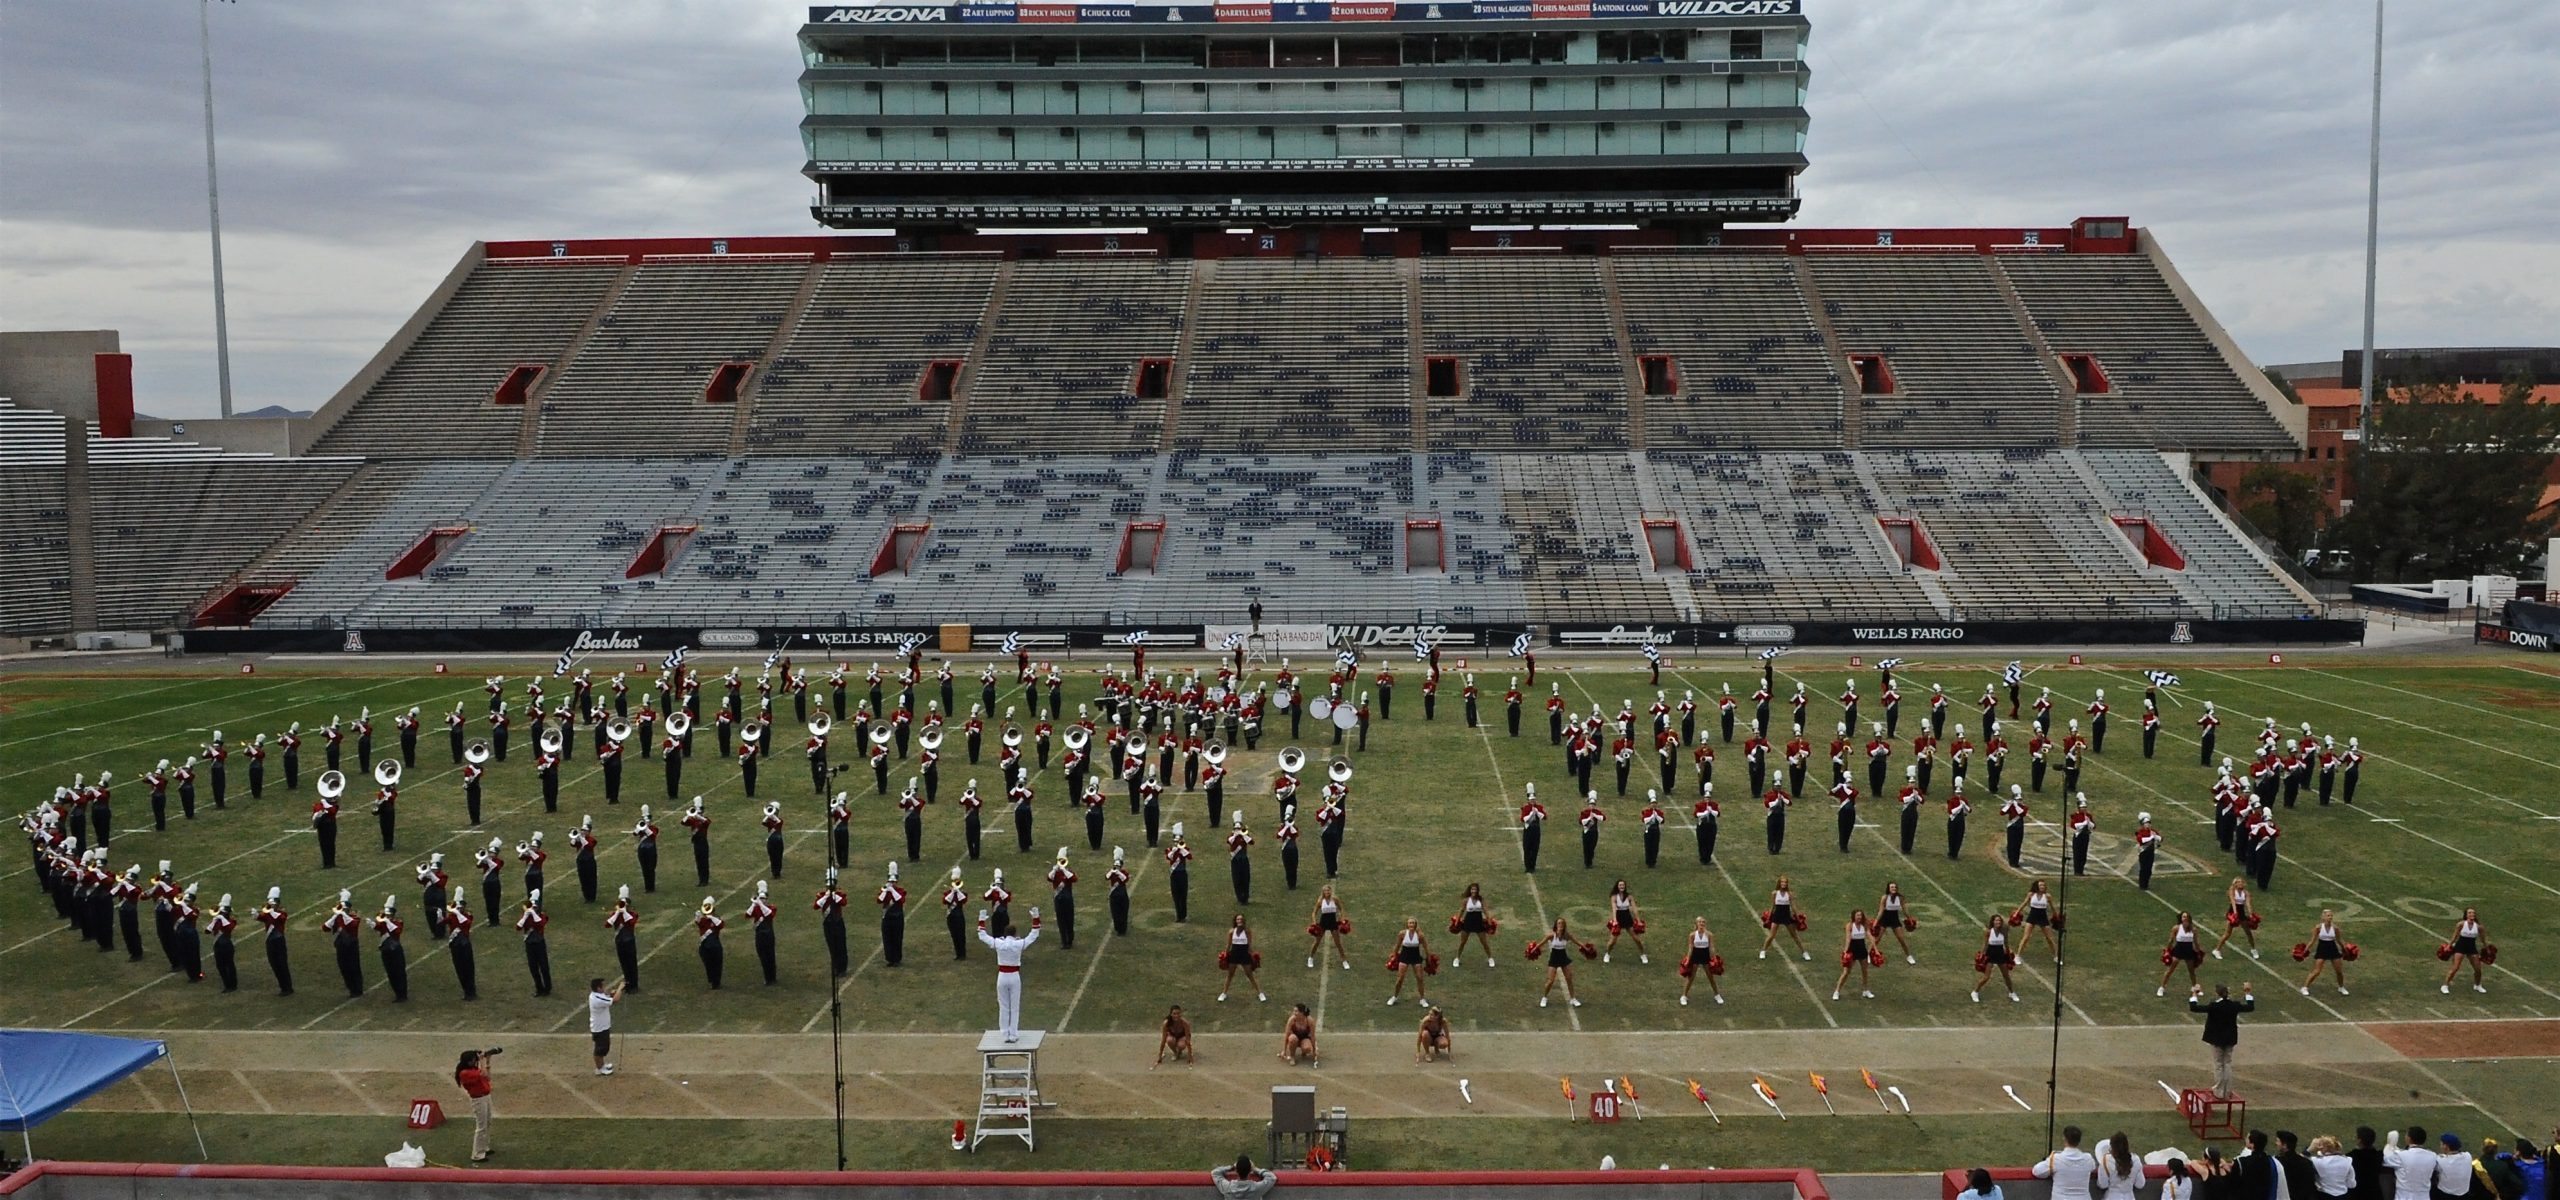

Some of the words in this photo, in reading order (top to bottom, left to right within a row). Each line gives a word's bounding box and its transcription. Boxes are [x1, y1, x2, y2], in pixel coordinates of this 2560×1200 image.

[963, 8, 971, 17] 22
[972, 9, 985, 17] ART
[986, 9, 1015, 17] LUPPINO
[1028, 9, 1048, 17] RICKY
[1050, 9, 1075, 17] HUNLEY
[1087, 9, 1111, 17] CHUCK
[1112, 9, 1131, 17] CECIL
[1214, 8, 1219, 17] 4
[1220, 9, 1249, 17] DARRYLL
[1251, 9, 1271, 17] LEWIS
[1340, 7, 1354, 15] ROB
[1356, 7, 1388, 15] WALDROP
[1482, 6, 1497, 14] STEVE
[1658, 1, 1792, 15] WILDCATS
[824, 8, 946, 22] ARIZONA
[1105, 241, 1119, 251] 20
[1261, 239, 1273, 249] 21
[1498, 237, 1511, 248] 22
[1878, 236, 1892, 246] 24
[2024, 236, 2038, 246] 25
[554, 247, 564, 257] 17
[713, 245, 727, 255] 18
[898, 243, 909, 253] 19
[174, 424, 185, 434] 16
[816, 633, 871, 644] WELLS
[874, 633, 927, 644] FARGO
[1288, 632, 1308, 642] BAND
[1310, 632, 1323, 642] DAY
[1853, 628, 1908, 639] WELLS
[1911, 628, 1964, 639] FARGO
[573, 630, 643, 650] Bashas'
[1594, 1097, 1614, 1117] 40
[410, 1104, 431, 1125] 40
